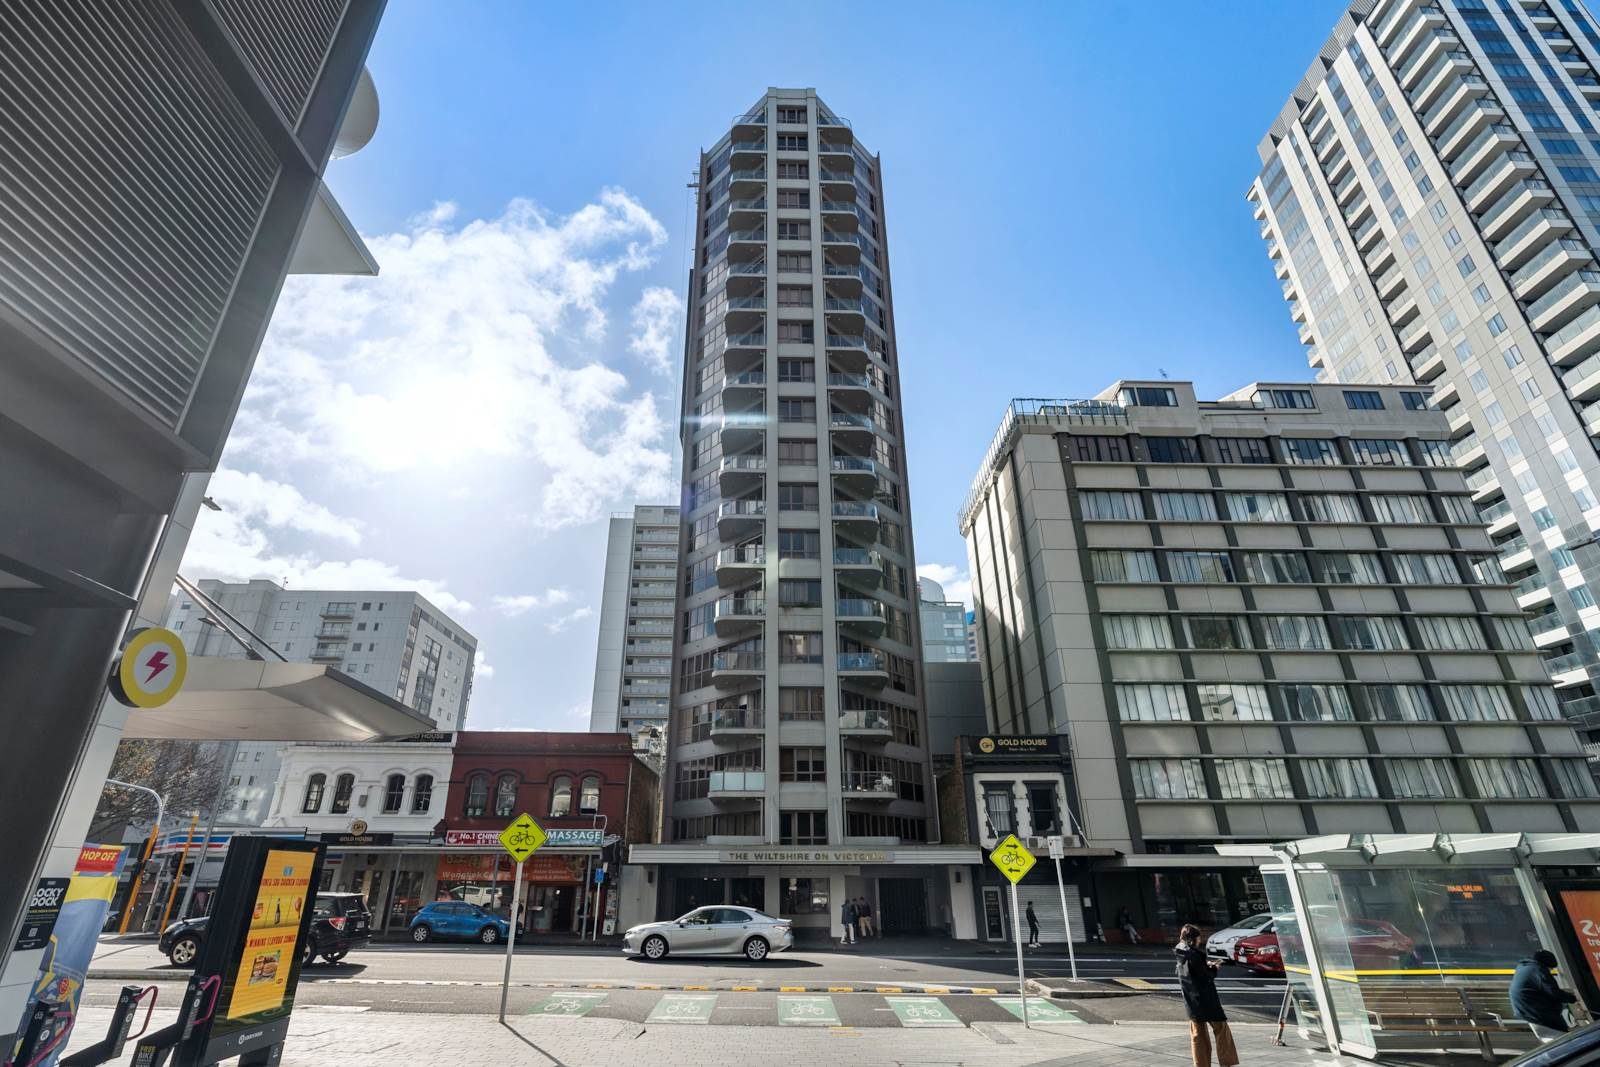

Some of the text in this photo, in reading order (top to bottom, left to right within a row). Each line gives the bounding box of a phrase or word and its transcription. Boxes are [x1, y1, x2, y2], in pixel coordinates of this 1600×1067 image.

[997, 738, 1048, 746] GOLD HOUSE
[547, 831, 601, 840] MASSAGE
[81, 850, 117, 861] HOP OFF
[729, 852, 886, 860] THE WILTSHIRE ON VICTO
[30, 897, 58, 907] DOCK
